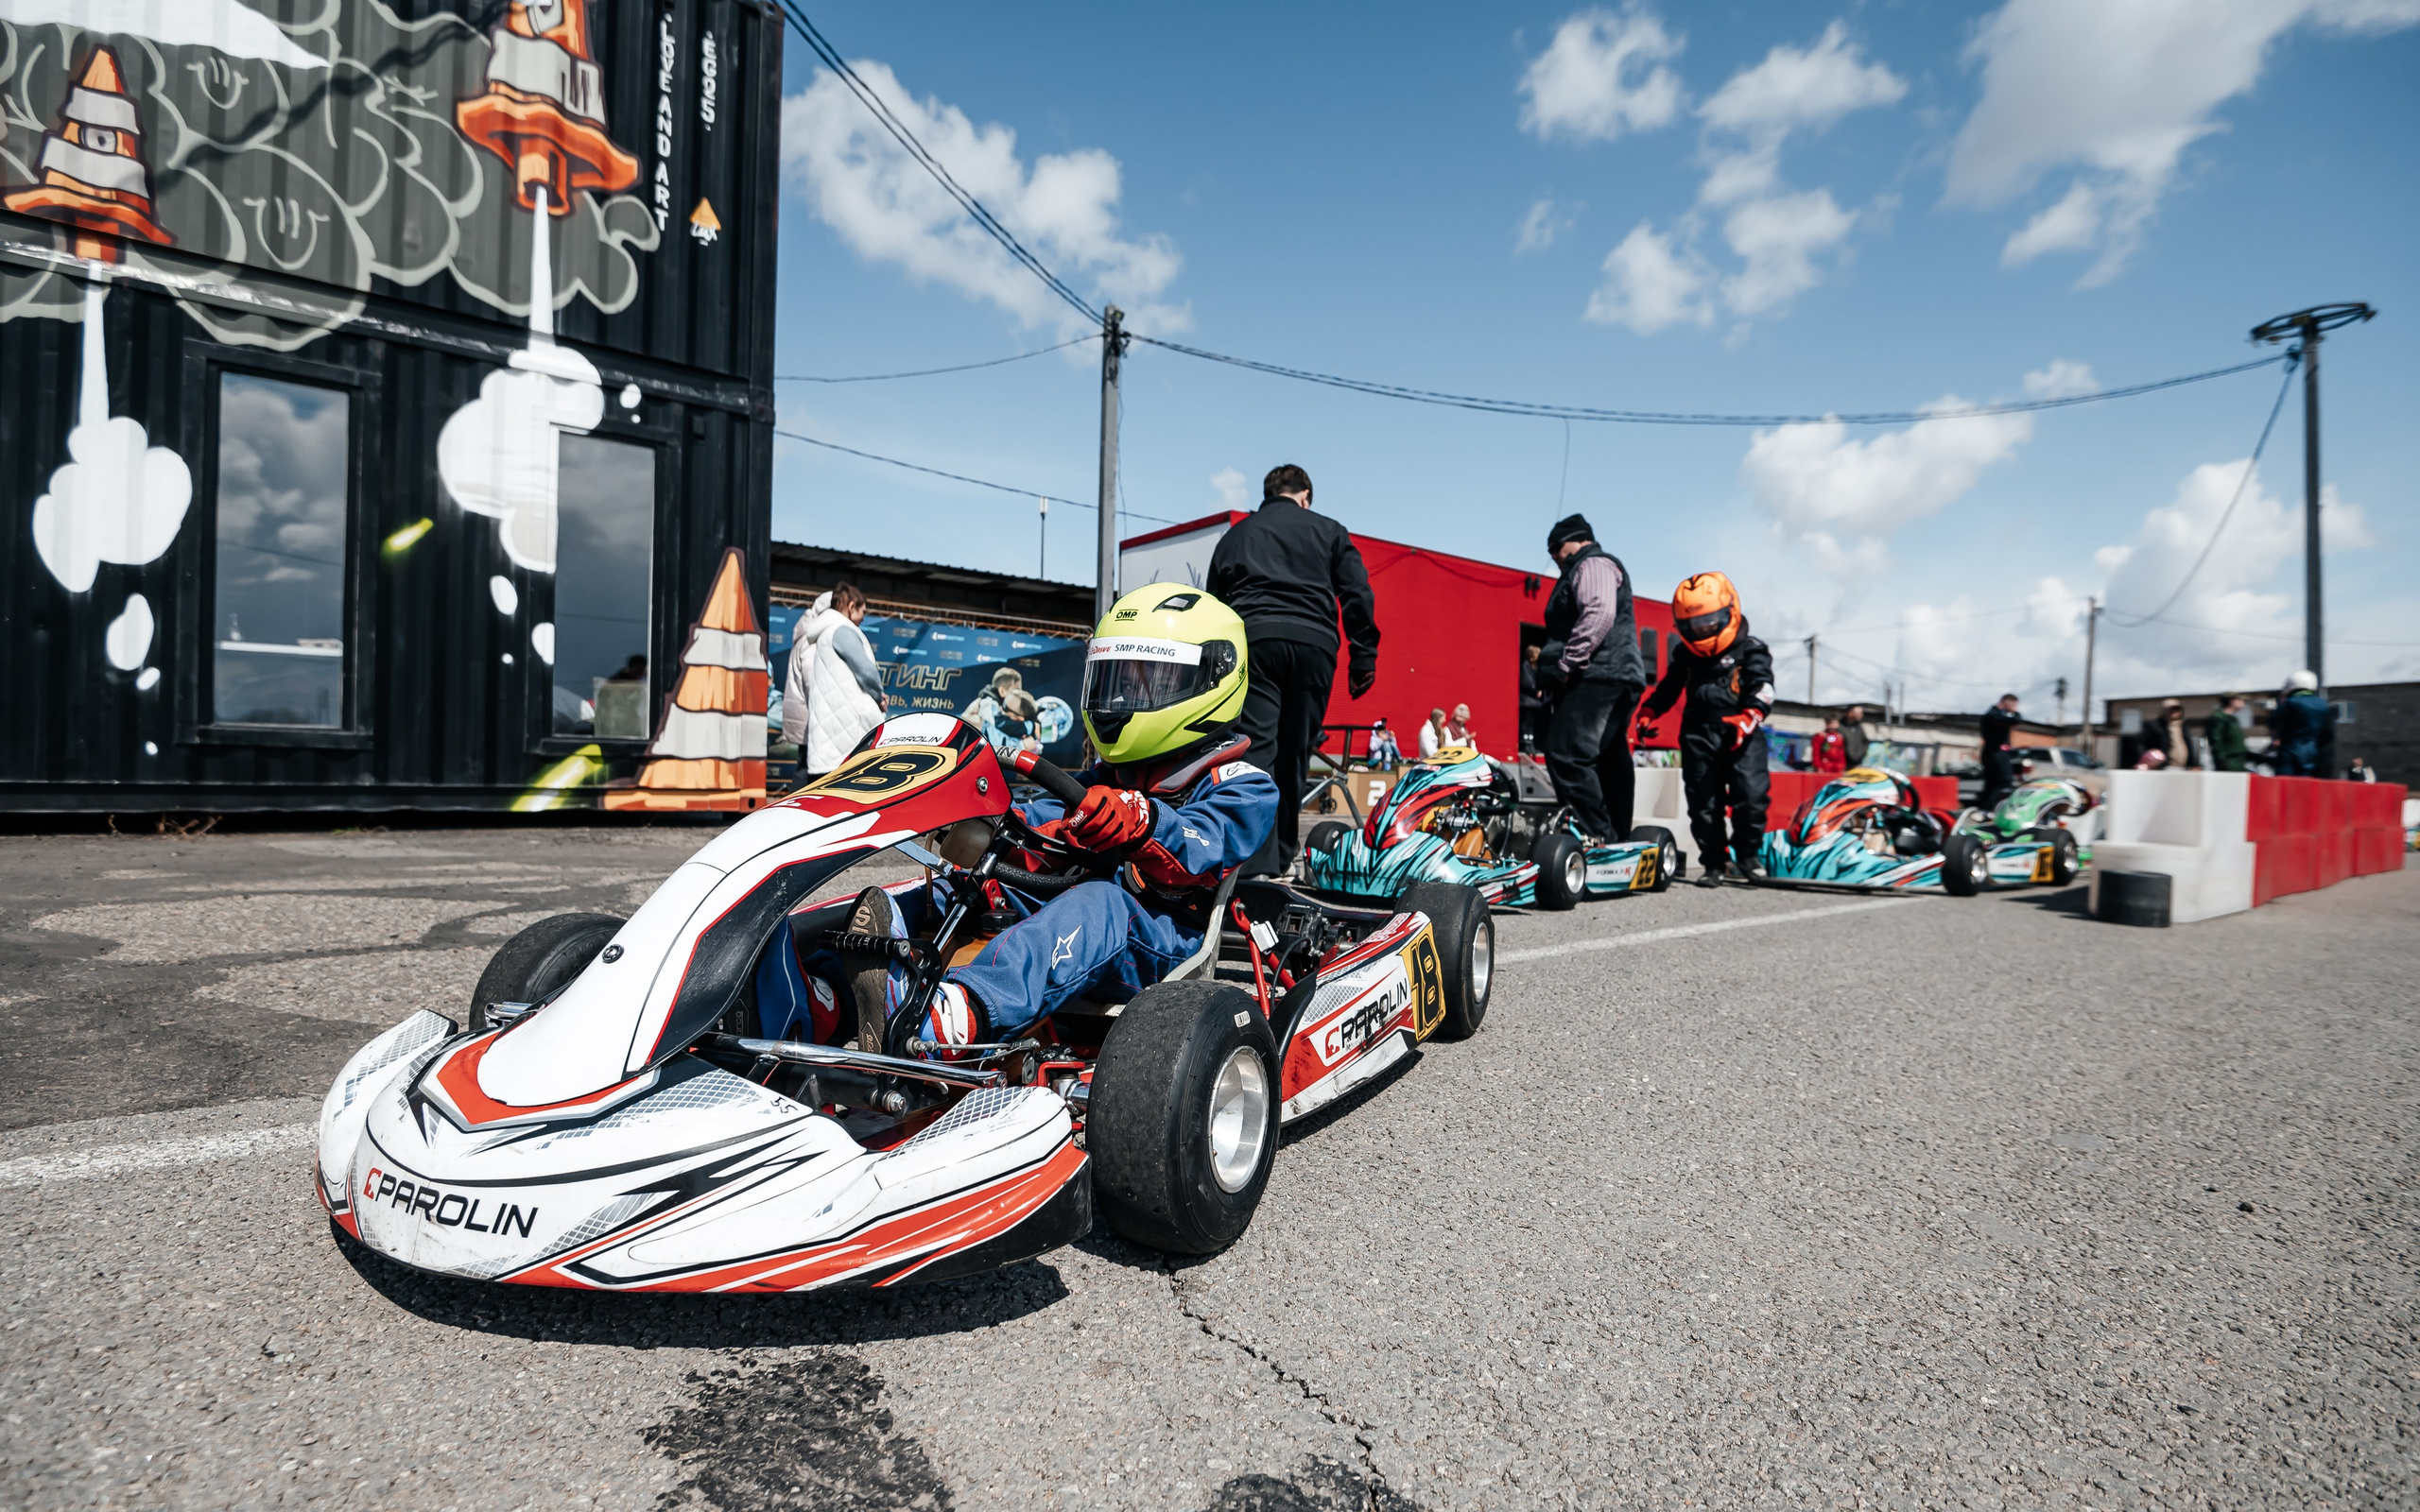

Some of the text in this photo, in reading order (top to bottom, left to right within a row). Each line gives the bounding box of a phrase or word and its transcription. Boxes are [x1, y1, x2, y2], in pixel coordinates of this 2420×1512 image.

[657, 94, 672, 158] AND
[654, 161, 671, 232] ART
[1115, 610, 1138, 620] OMP
[1115, 644, 1135, 653] SMP
[1136, 644, 1176, 657] RACING
[1367, 780, 1387, 807] 2
[1637, 852, 1656, 885] 22
[1411, 934, 1443, 1038] 18
